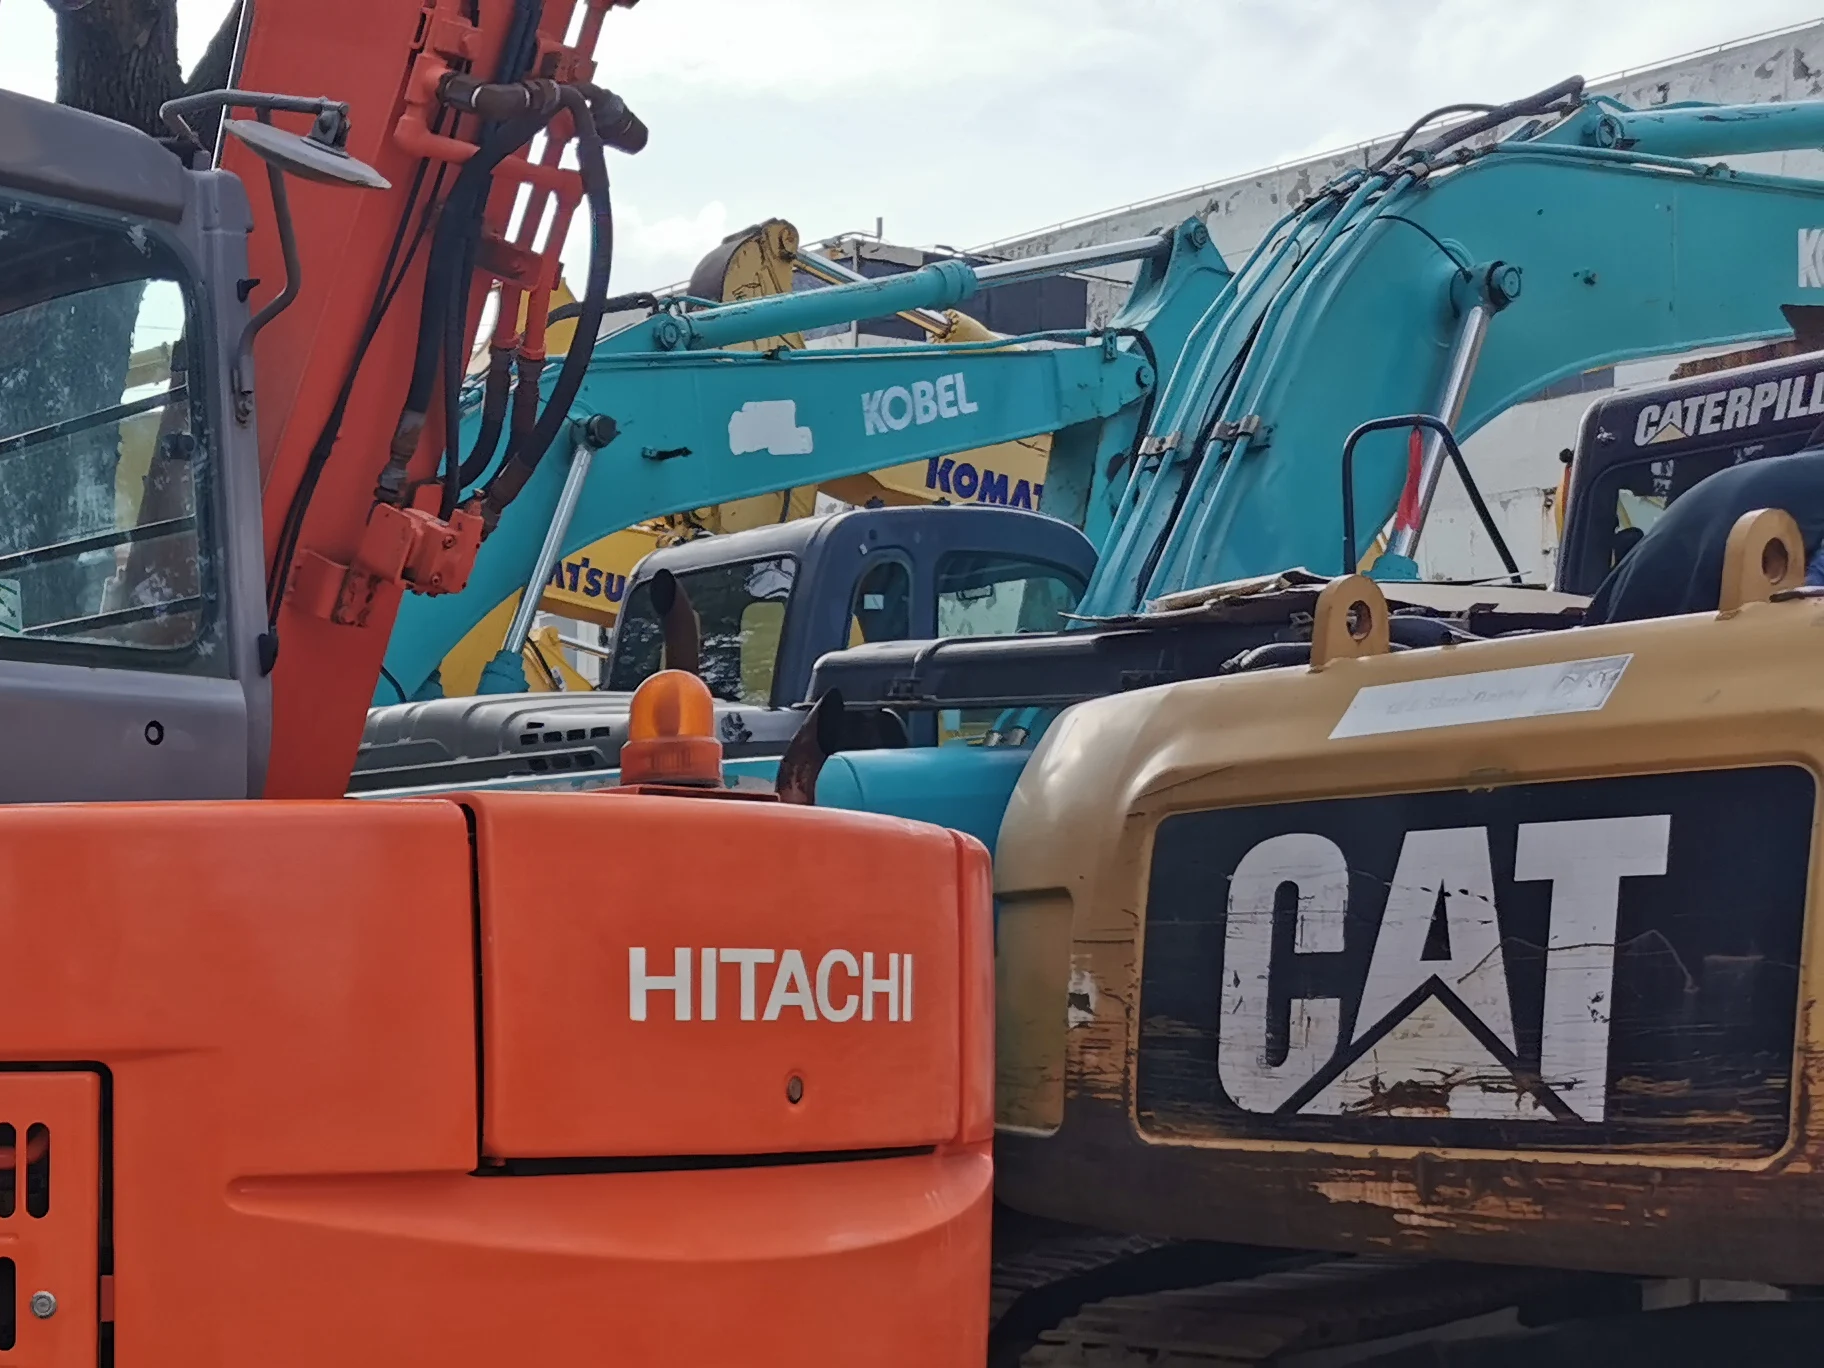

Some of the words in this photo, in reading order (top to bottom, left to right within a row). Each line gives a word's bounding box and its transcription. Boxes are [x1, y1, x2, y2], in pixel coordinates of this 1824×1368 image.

[861, 371, 979, 436] KOBEL
[1634, 371, 1824, 447] CATERPILL
[629, 947, 913, 1022] HITACHI
[1217, 814, 1672, 1122] CAT
